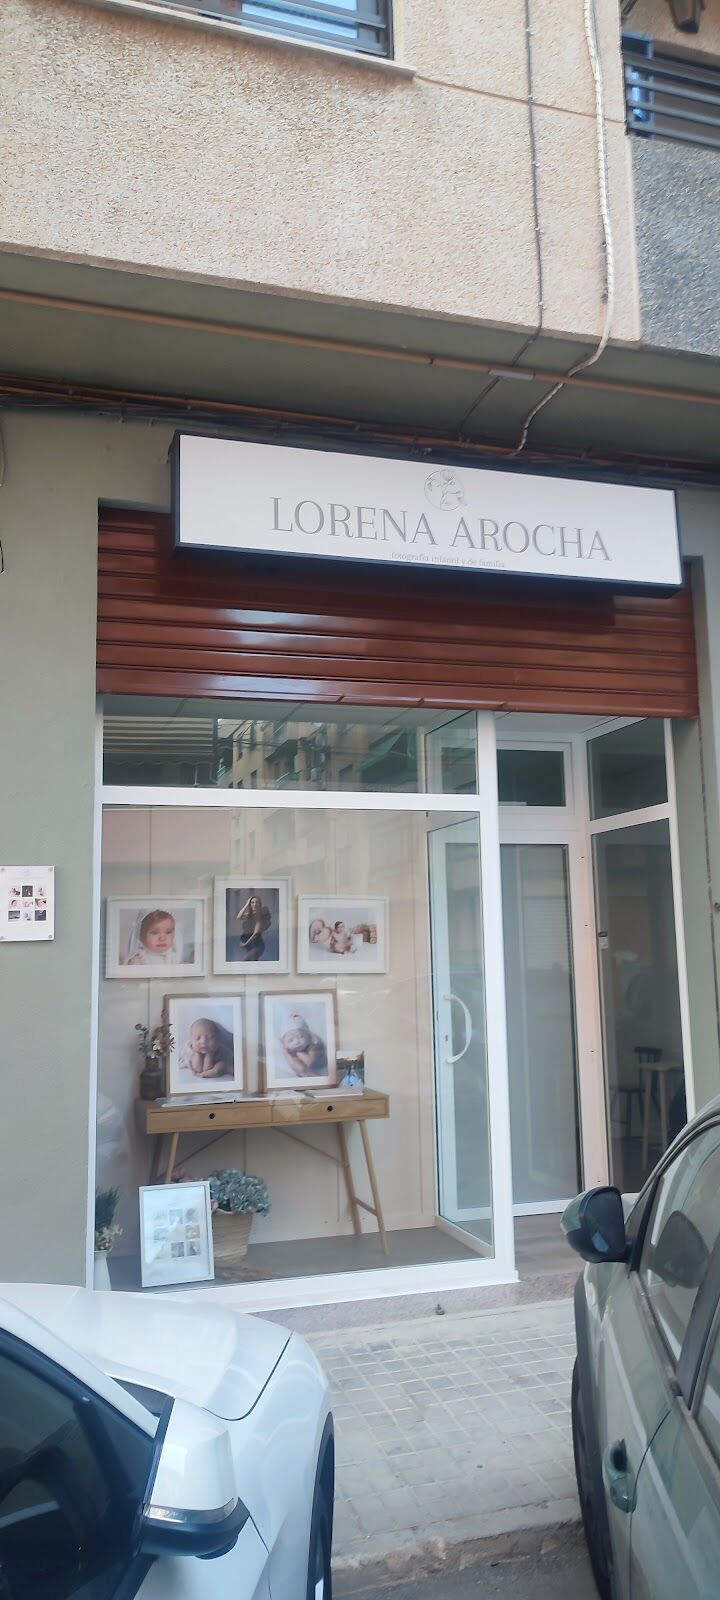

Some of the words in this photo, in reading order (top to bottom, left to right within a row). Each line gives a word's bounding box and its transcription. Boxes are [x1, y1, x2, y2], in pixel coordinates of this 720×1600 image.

[271, 497, 438, 546] LORENA
[450, 515, 611, 561] AROCHA
[431, 554, 459, 565] infantil
[467, 557, 477, 566] de
[478, 558, 505, 568] familia
